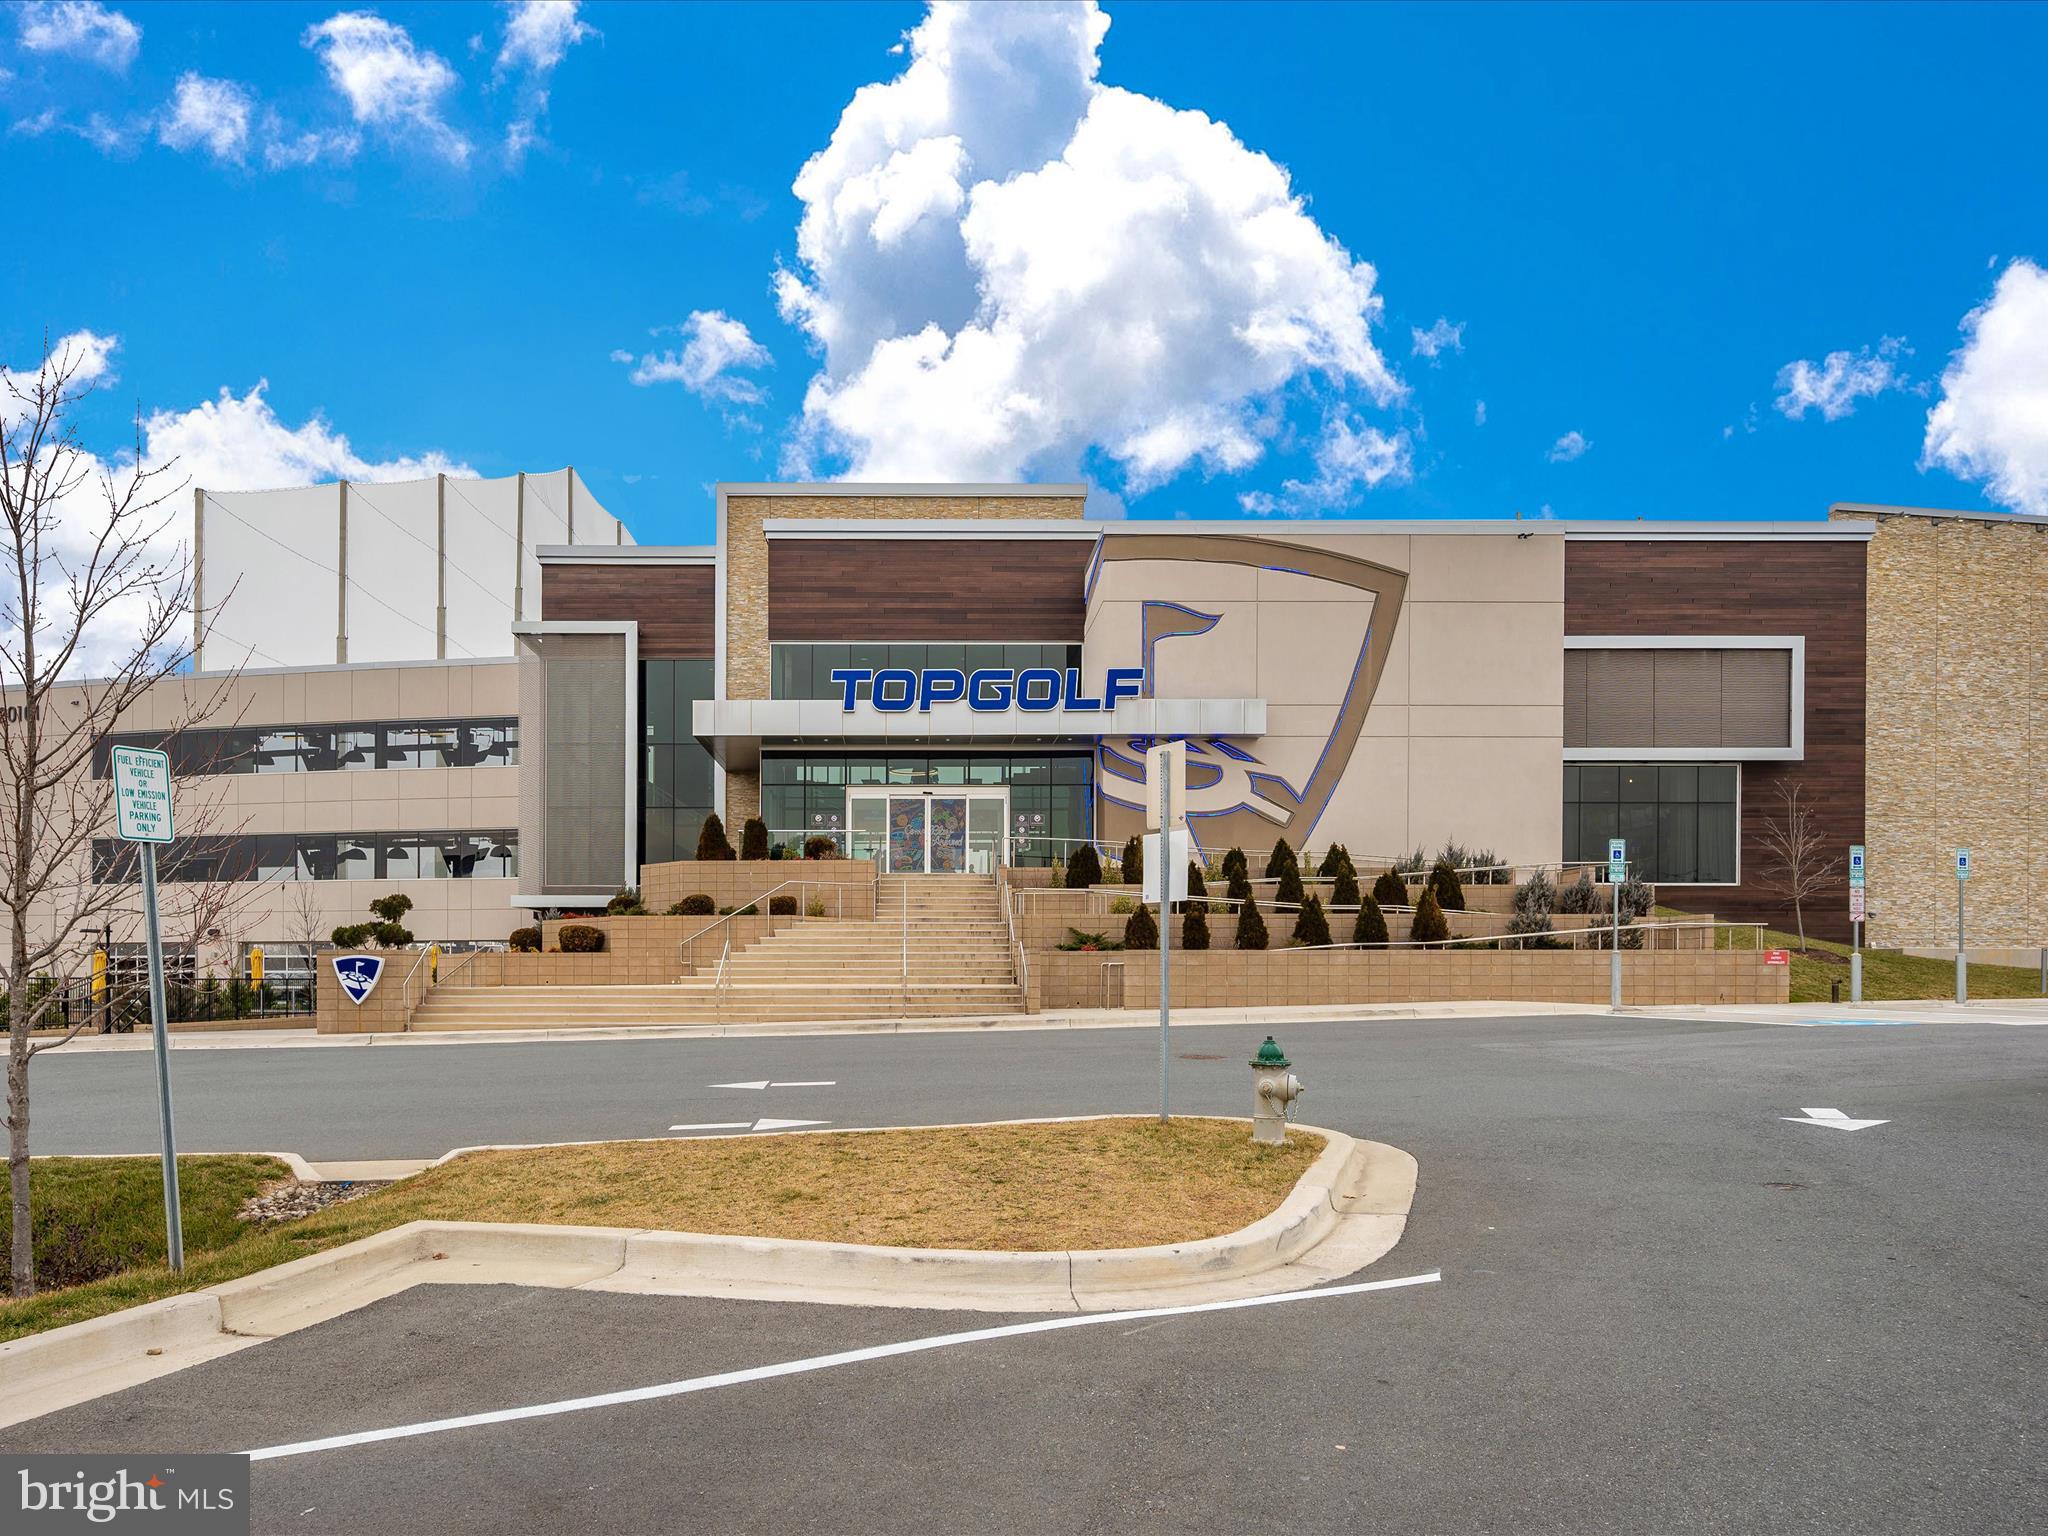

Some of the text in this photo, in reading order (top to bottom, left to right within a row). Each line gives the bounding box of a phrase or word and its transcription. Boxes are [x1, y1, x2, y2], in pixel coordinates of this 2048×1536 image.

[831, 667, 1145, 712] TOPGOLF
[118, 755, 164, 769] FUEL EFFICIENT
[130, 768, 154, 779] VEHICLE
[139, 780, 147, 788] OR
[121, 788, 166, 800] LOW EMISSION
[132, 800, 157, 811] VEHICLE
[129, 811, 162, 822] PARKING
[136, 823, 156, 833] ONLY
